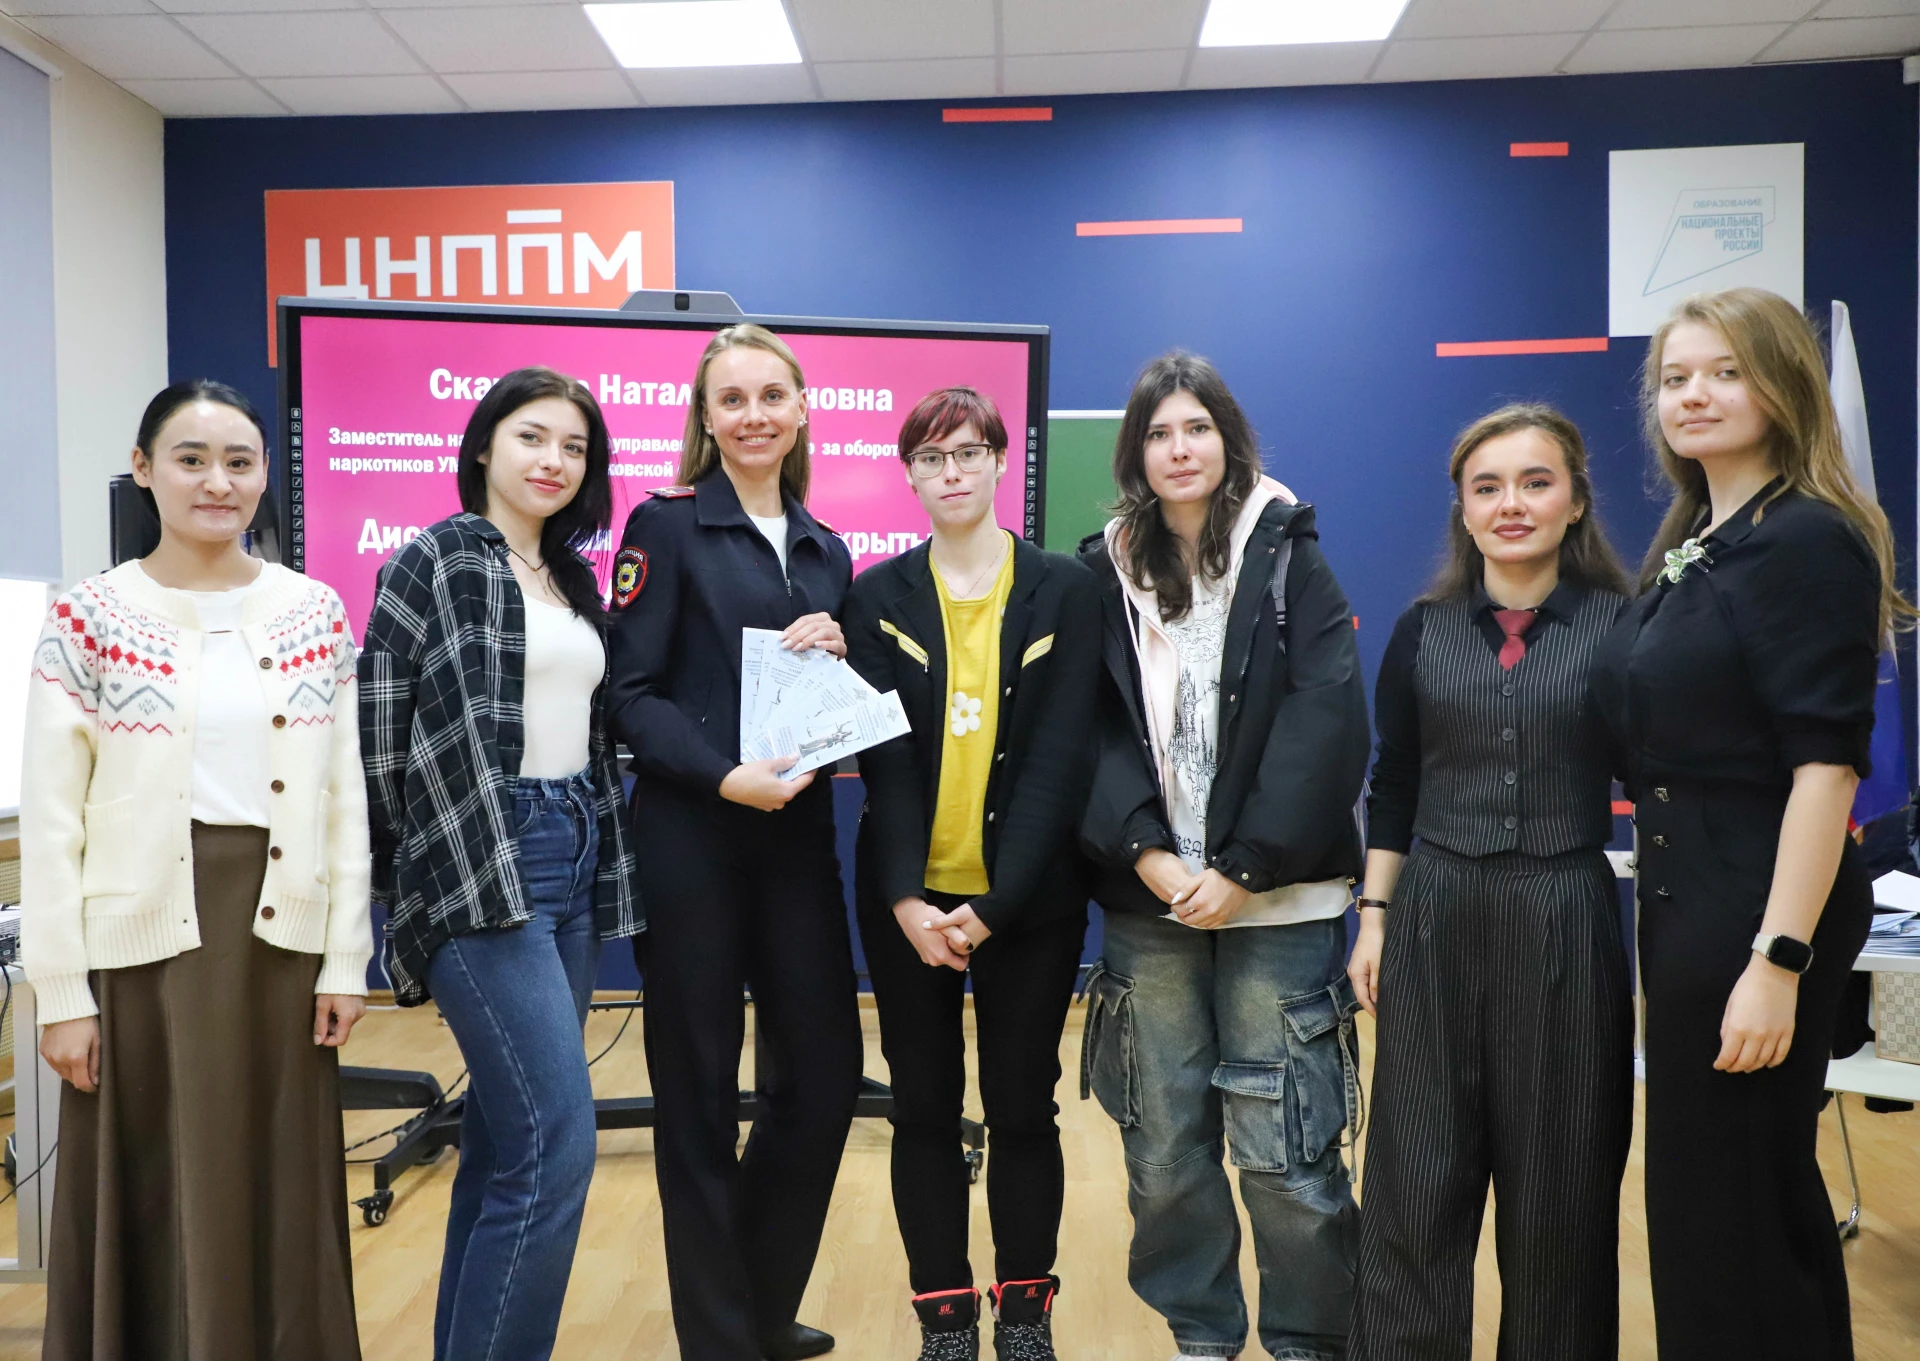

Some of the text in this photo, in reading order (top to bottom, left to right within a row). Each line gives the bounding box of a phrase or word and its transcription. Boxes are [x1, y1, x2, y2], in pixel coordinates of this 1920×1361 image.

[1693, 198, 1763, 209] ОБРАЗОВАНИЕ
[1681, 216, 1760, 229] НАЦИОНАЛЬНЫЕ
[1715, 227, 1760, 240] ПРОЕКТЫ
[1722, 239, 1760, 251] РОССИИ
[305, 208, 643, 300] ЦНППМ
[599, 373, 693, 406] Натал
[805, 387, 893, 412] новна
[328, 427, 444, 447] Заместитель
[821, 442, 841, 456] за
[843, 439, 899, 460] оборот
[328, 457, 435, 475] наркотиков
[437, 456, 459, 473] УМ
[607, 461, 674, 477] ковской
[357, 518, 427, 554] Дис
[618, 549, 644, 562] ПОЛИЦИЯ
